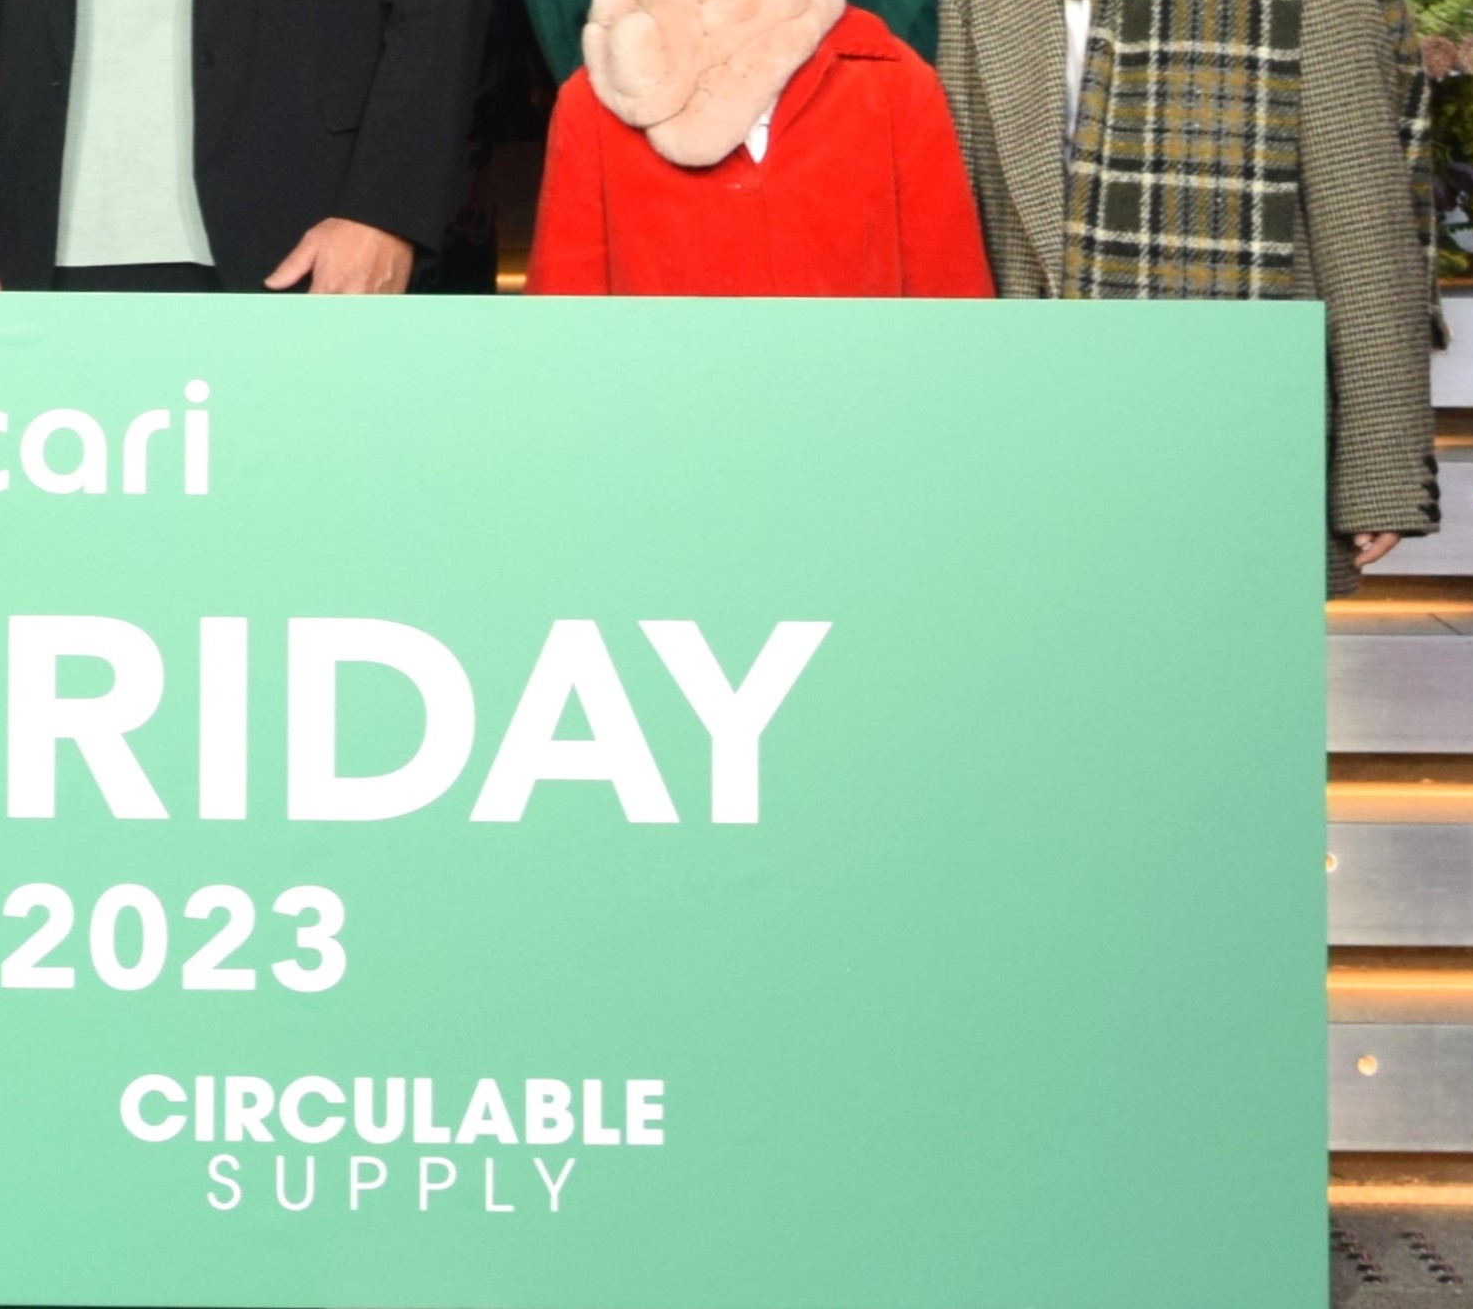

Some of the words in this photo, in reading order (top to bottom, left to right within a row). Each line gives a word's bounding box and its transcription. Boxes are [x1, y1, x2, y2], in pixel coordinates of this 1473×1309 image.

[1, 883, 346, 992] 2023
[120, 1074, 665, 1145] CIRCULABLE
[207, 1154, 575, 1212] SUPPLY
